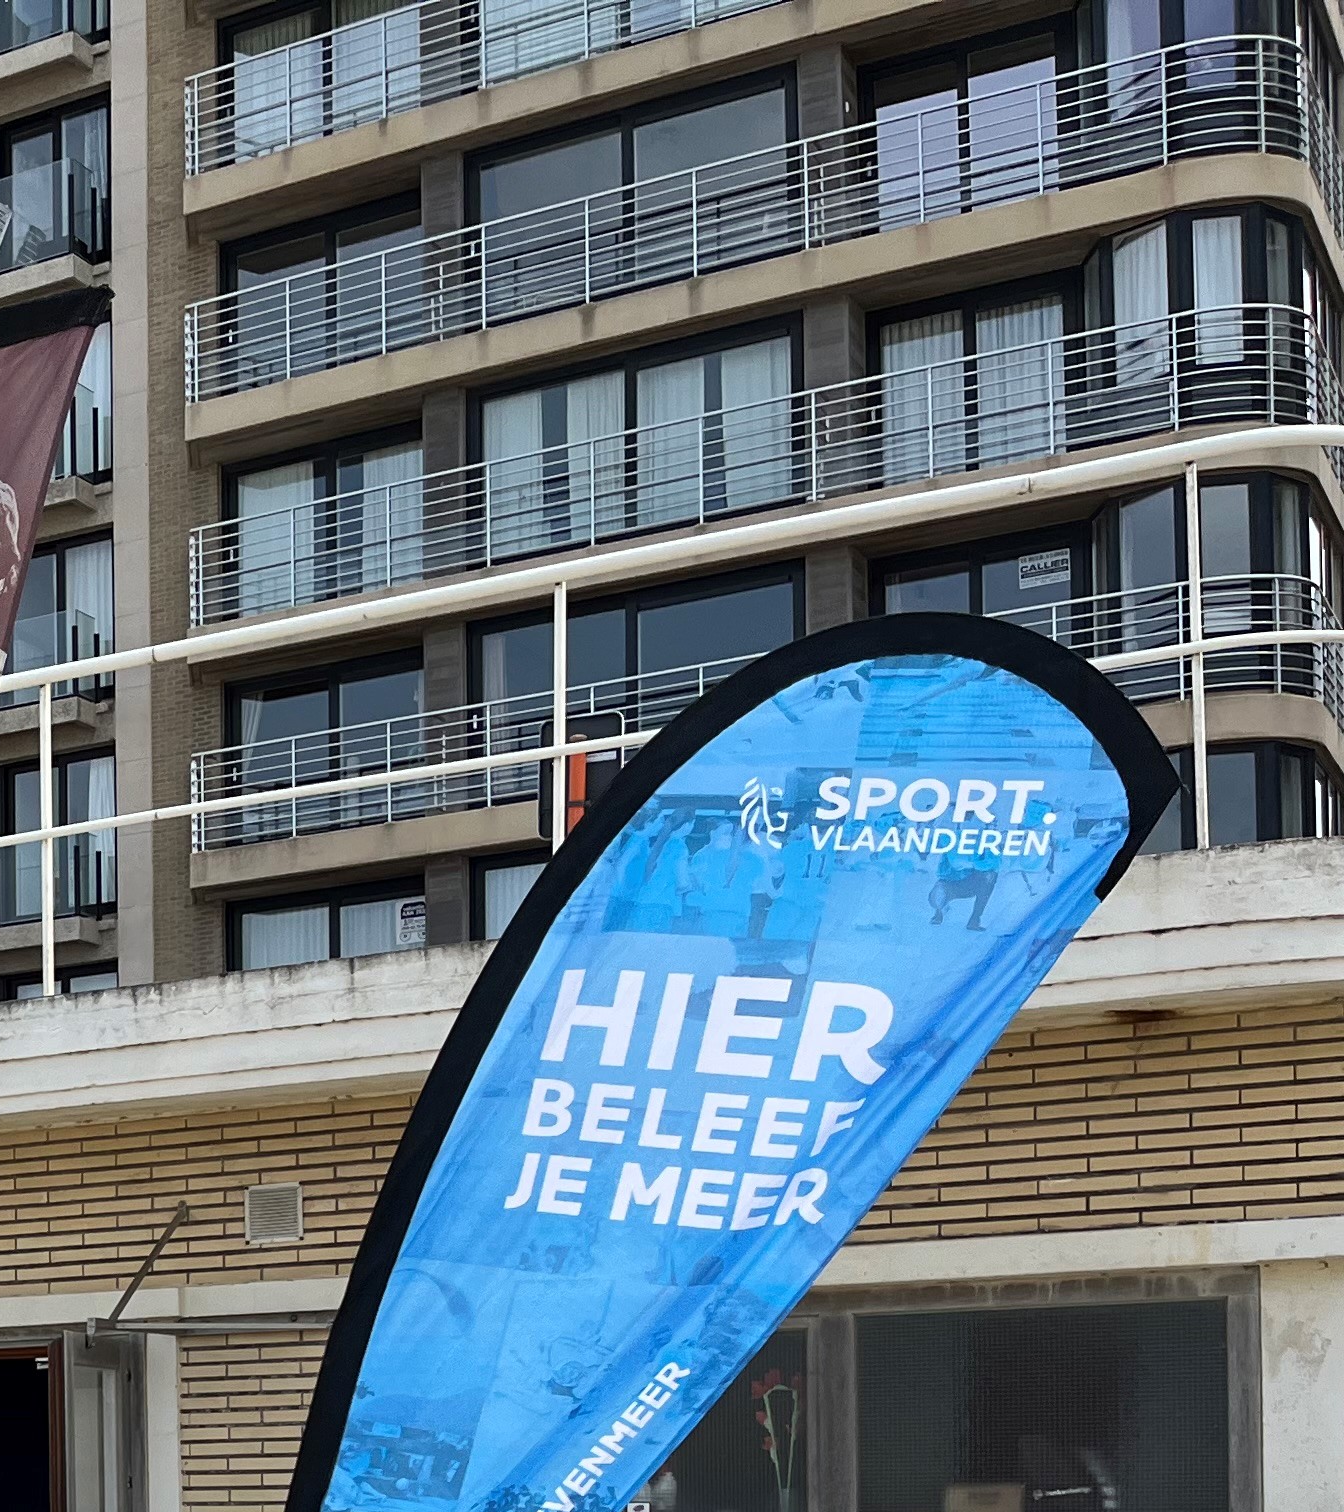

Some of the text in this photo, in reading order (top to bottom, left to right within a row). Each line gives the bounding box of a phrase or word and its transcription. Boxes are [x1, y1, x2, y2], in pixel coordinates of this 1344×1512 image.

[810, 825, 1051, 856] VLAANDEREN
[815, 775, 1057, 827] SPORT.
[539, 968, 895, 1085] HIER
[521, 1077, 867, 1158] BELEEF
[504, 1152, 827, 1232] JE MEER
